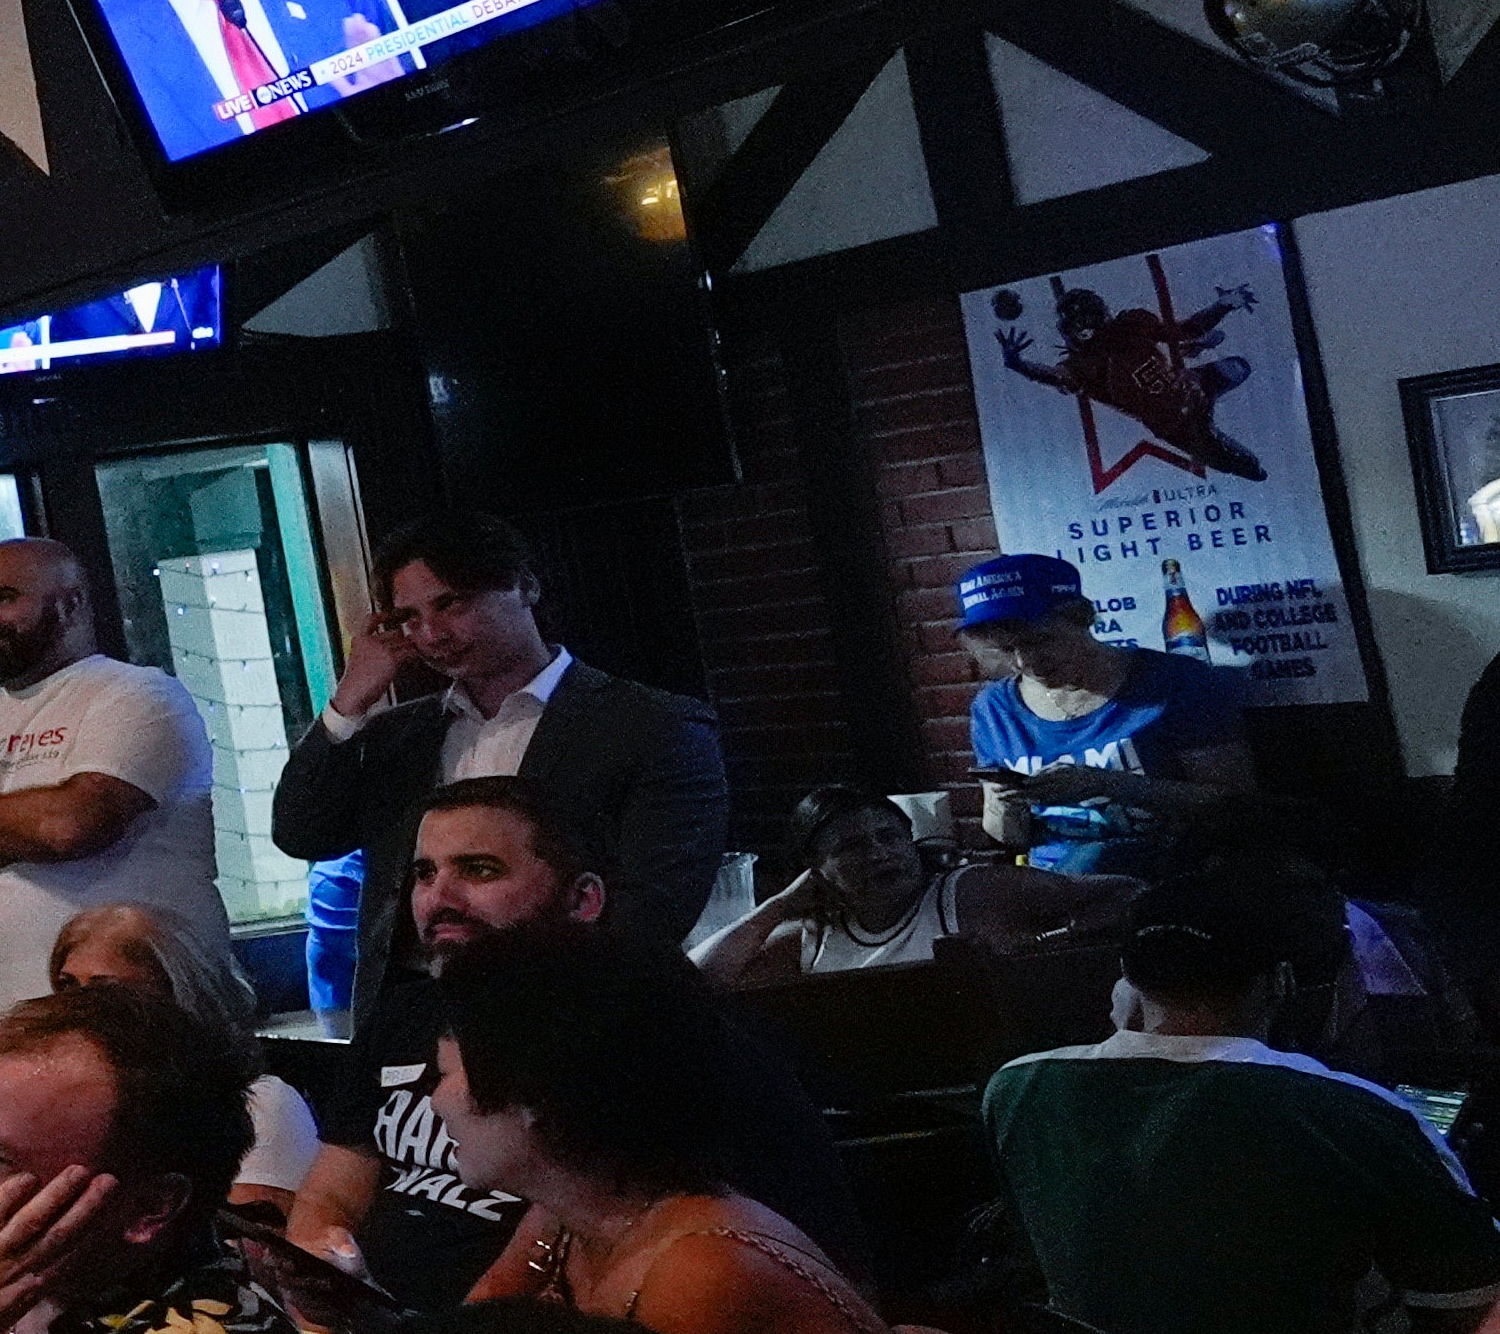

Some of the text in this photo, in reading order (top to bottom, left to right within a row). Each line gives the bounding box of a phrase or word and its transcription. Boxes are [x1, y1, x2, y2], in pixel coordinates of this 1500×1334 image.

[330, 51, 364, 75] 2024
[367, 14, 469, 60] PRESIDENTIAL
[217, 70, 312, 120] LIVE NEWS
[1069, 501, 1245, 540] SUPERIOR
[1188, 524, 1272, 552] BEER
[1216, 581, 1284, 606] DURING
[1253, 602, 1338, 629] COLLEGE
[1230, 631, 1329, 656] FOOTBALL
[384, 1166, 523, 1223] WALZ
